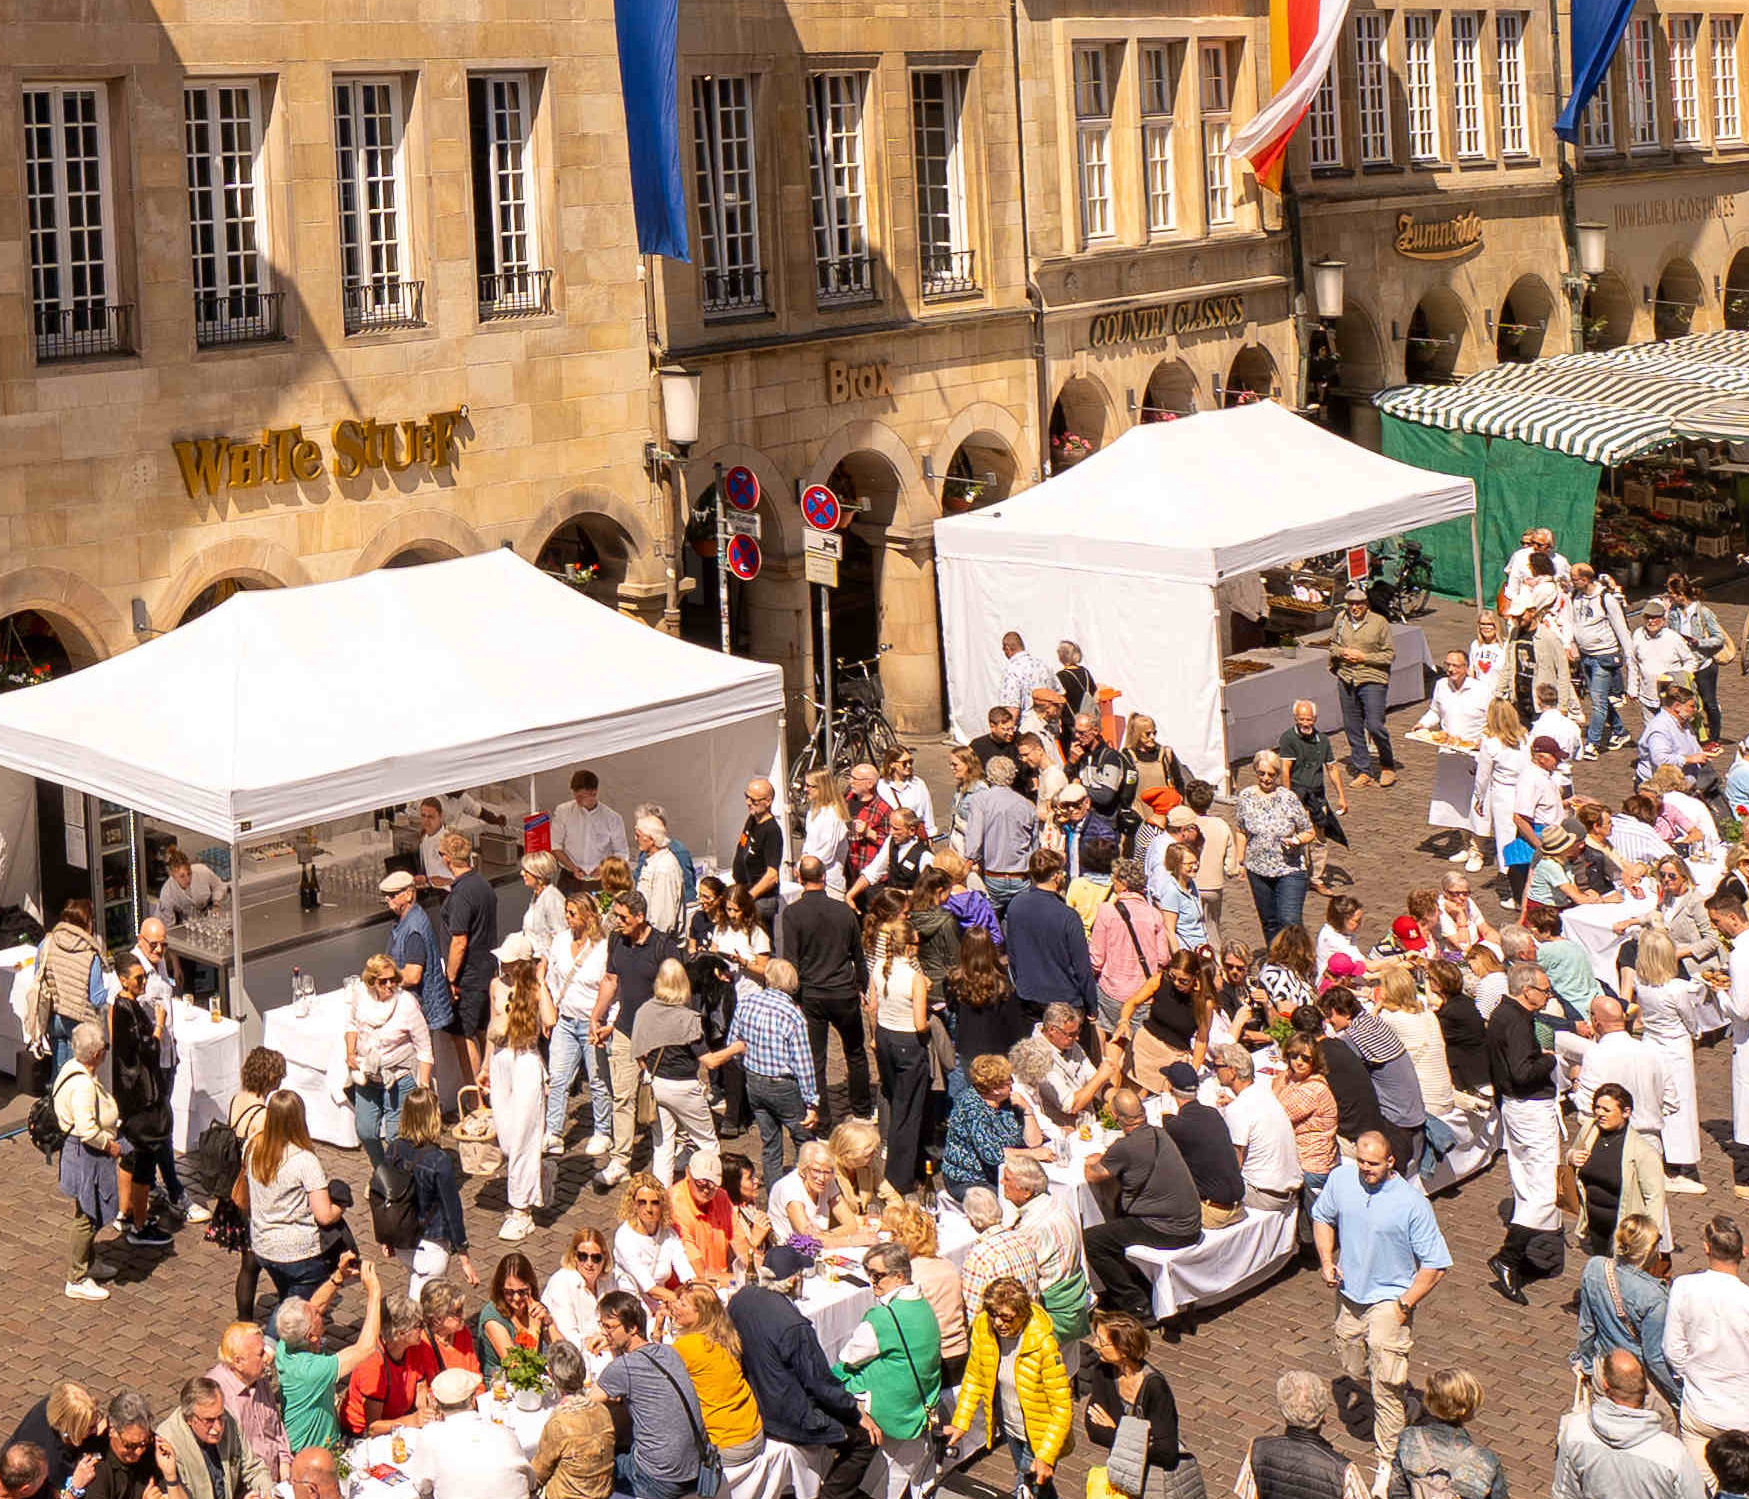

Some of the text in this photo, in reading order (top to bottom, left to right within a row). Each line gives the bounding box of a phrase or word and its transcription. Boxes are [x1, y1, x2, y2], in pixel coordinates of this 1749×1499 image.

[1089, 293, 1244, 347] COUNTRY CLASSICS
[825, 360, 893, 404] Brax
